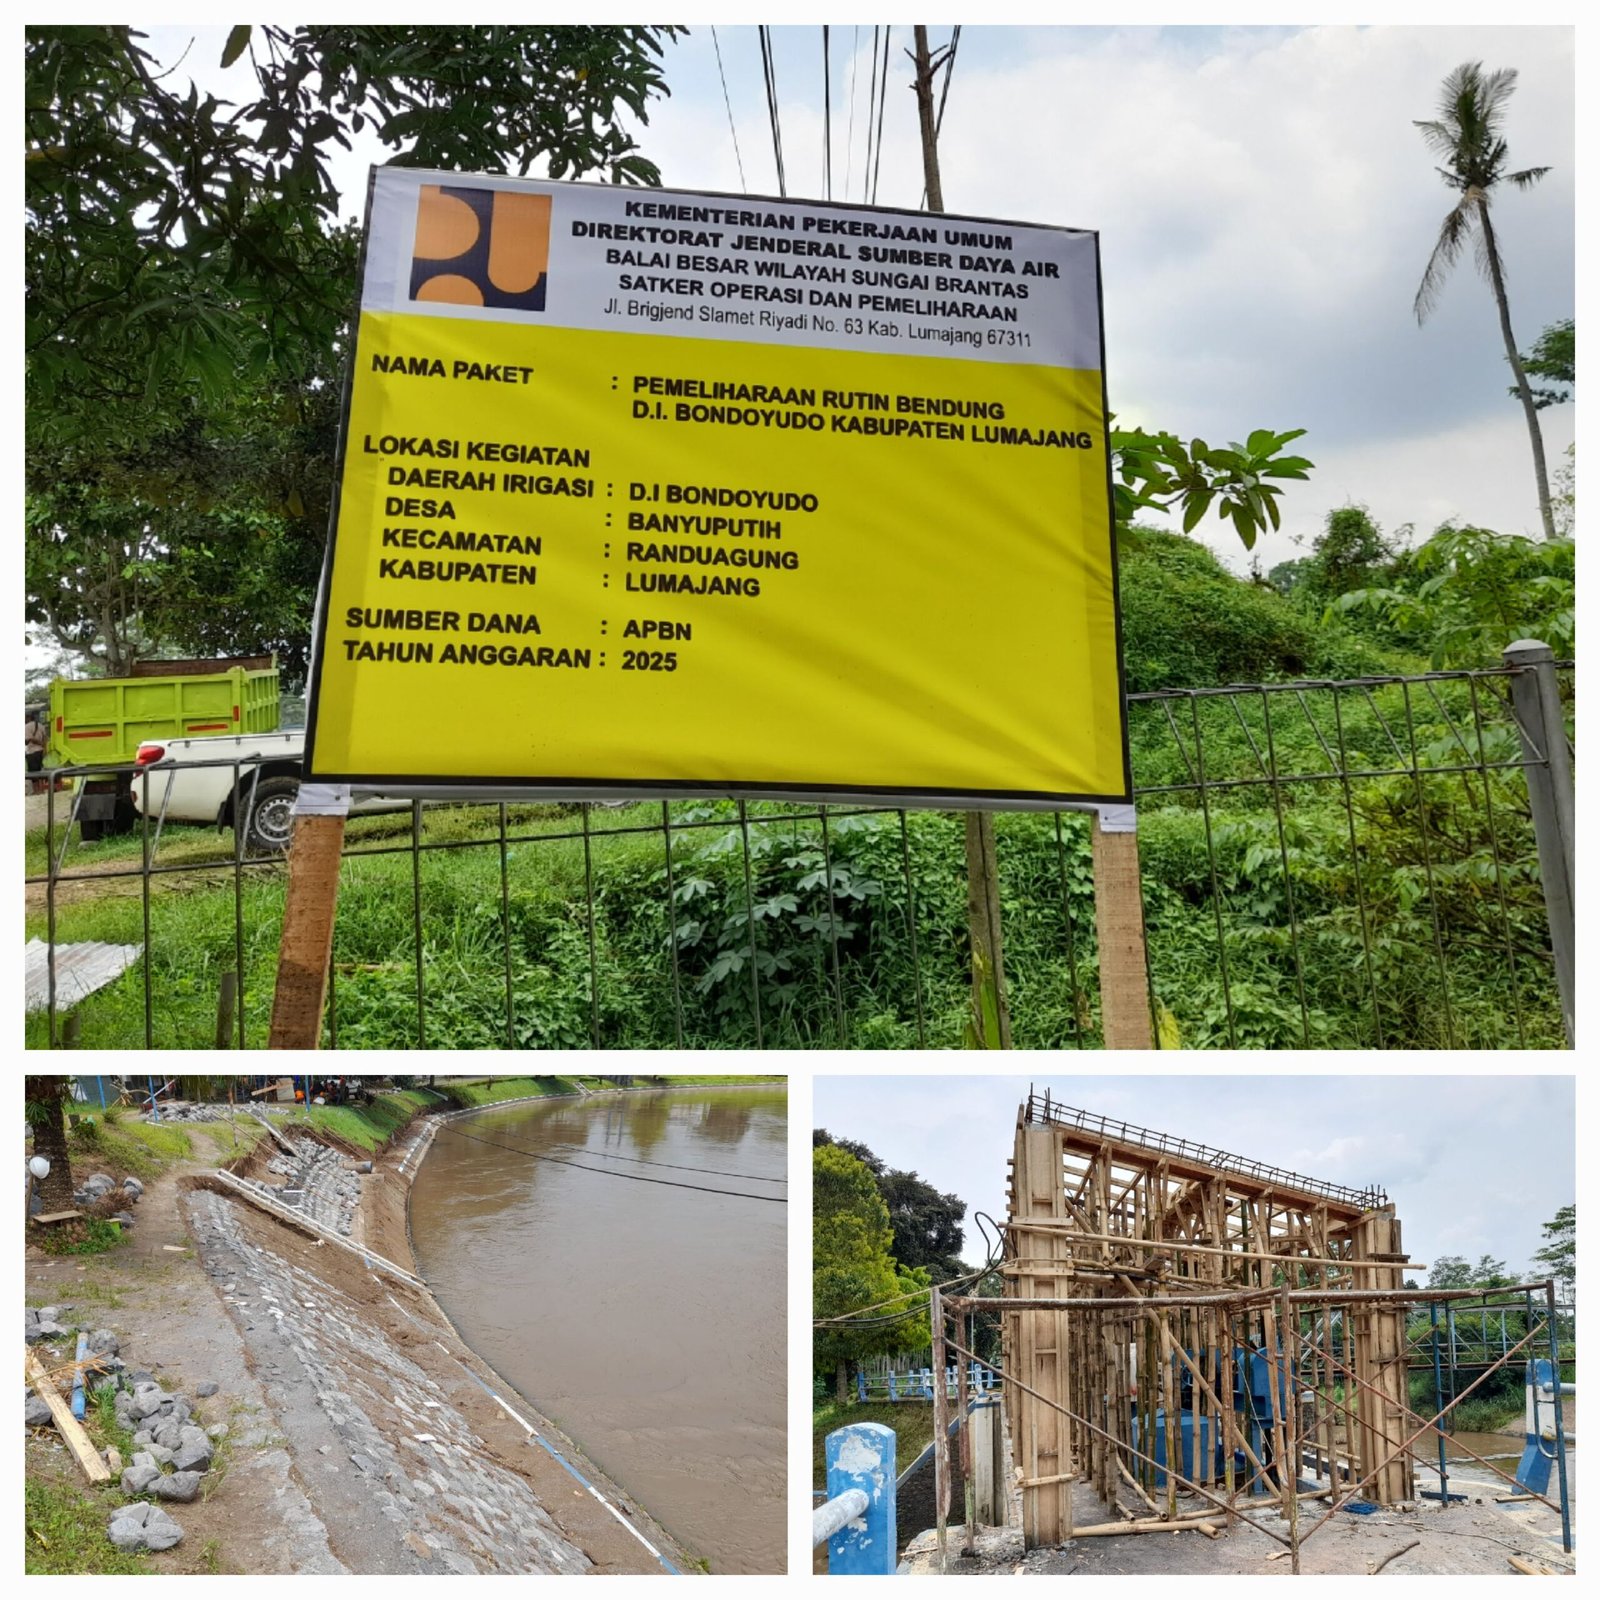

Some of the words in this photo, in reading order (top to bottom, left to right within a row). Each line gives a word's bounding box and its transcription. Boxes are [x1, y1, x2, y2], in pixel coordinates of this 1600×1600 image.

[626, 201, 794, 230] KEMENTERIAN
[803, 217, 937, 243] PEKERJAAN
[945, 230, 1012, 250] UMUM
[572, 221, 723, 247] DIREKTORAT
[731, 235, 851, 259] JENDERAL
[858, 246, 953, 269] SUMBER
[960, 255, 1015, 274] DAYA
[1022, 261, 1059, 278] AIR
[607, 249, 670, 268] BALAI
[677, 255, 748, 275] BESAR
[755, 261, 845, 283] WILAYAH
[852, 270, 928, 290] SUNGAI
[936, 276, 1028, 298] BRANTAS
[619, 275, 703, 296] SATKER
[710, 282, 802, 304] OPERASI
[810, 290, 851, 308] DAN
[859, 295, 1017, 321] PEMELIHARAAN
[605, 299, 621, 314] Jl.
[628, 300, 693, 321] Brigjend
[699, 306, 754, 325] Slamet
[760, 311, 807, 331] Riyadi
[813, 315, 839, 331] No.
[845, 318, 863, 334] 63
[869, 320, 902, 337] Kab.
[909, 324, 982, 348] Lumajang
[988, 330, 1030, 346] 67311
[372, 354, 446, 377] NAMA
[453, 361, 533, 384] PAKET
[634, 376, 815, 406] PEMELIHARAAN
[823, 390, 889, 411] RUTIN
[897, 396, 1004, 419] BENDUNG
[633, 400, 667, 419] D.I.
[676, 403, 825, 431] BONDOYUDO
[832, 415, 964, 440] KABUPATEN
[972, 425, 1092, 449] LUMAJANG
[364, 435, 459, 458] LOKASI
[467, 442, 589, 468] KEGIATAN
[389, 467, 495, 491] DAERAH
[503, 474, 593, 497] IRIGASI
[630, 483, 659, 501] D.I
[666, 485, 818, 512] BONDOYUDO
[386, 497, 455, 519] DESA
[628, 512, 780, 539] BANYUPUTIH
[383, 528, 541, 555] KECAMATAN
[628, 542, 798, 569] RANDUAGUNG
[380, 559, 536, 584] KABUPATEN
[626, 573, 760, 597] LUMAJANG
[346, 608, 460, 631] SUMBER
[468, 613, 541, 634] DANA
[623, 620, 691, 640] APBN
[343, 640, 433, 663] TAHUN
[439, 644, 591, 668] ANGGARAN
[622, 650, 677, 672] 2025
